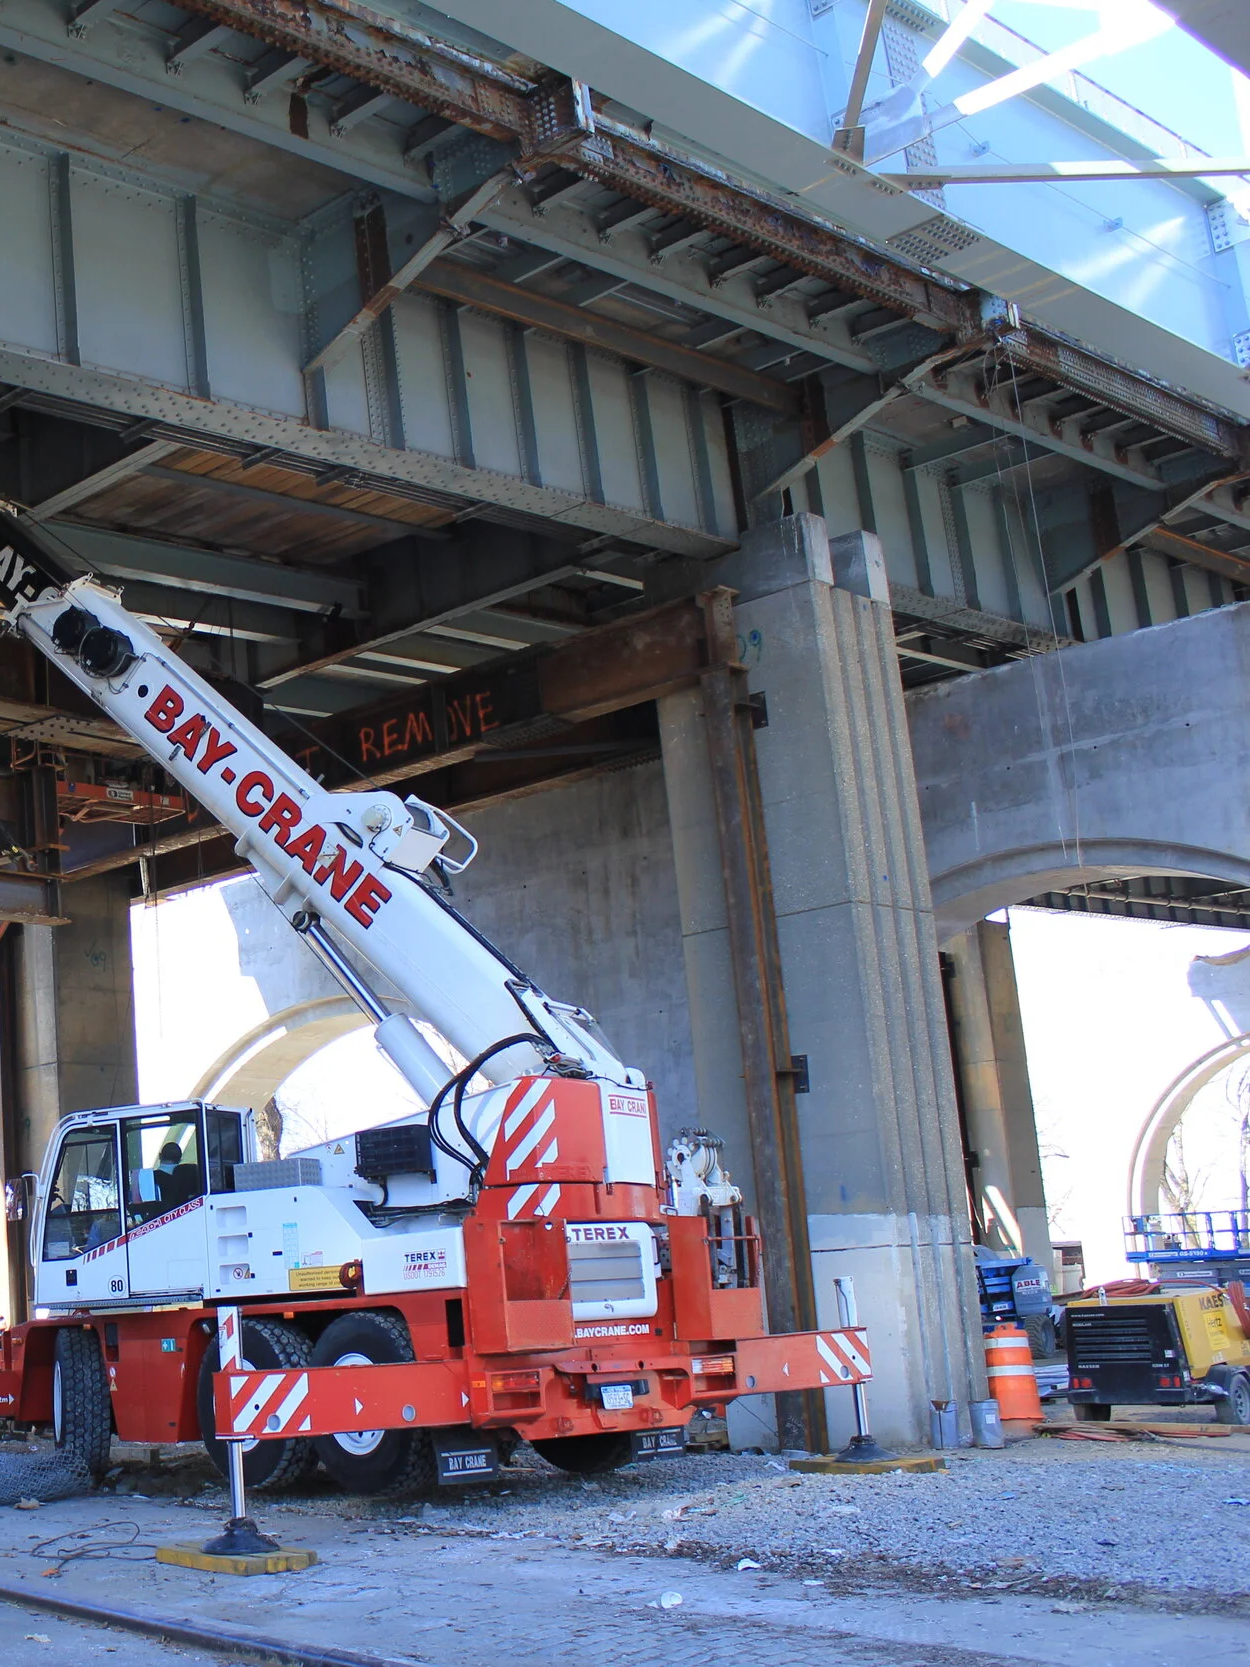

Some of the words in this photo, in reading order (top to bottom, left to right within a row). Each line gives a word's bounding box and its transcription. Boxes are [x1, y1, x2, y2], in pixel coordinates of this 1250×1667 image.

[144, 684, 392, 930] BAY-CRANE
[609, 1098, 625, 1112] BAY
[179, 1199, 201, 1216] CLASS
[571, 1226, 630, 1242] TEREX
[404, 1251, 437, 1263] TEREX
[110, 1279, 124, 1292] 80
[642, 1435, 656, 1449] BAY
[448, 1456, 463, 1471] BAY
[464, 1454, 487, 1469] CRANE
